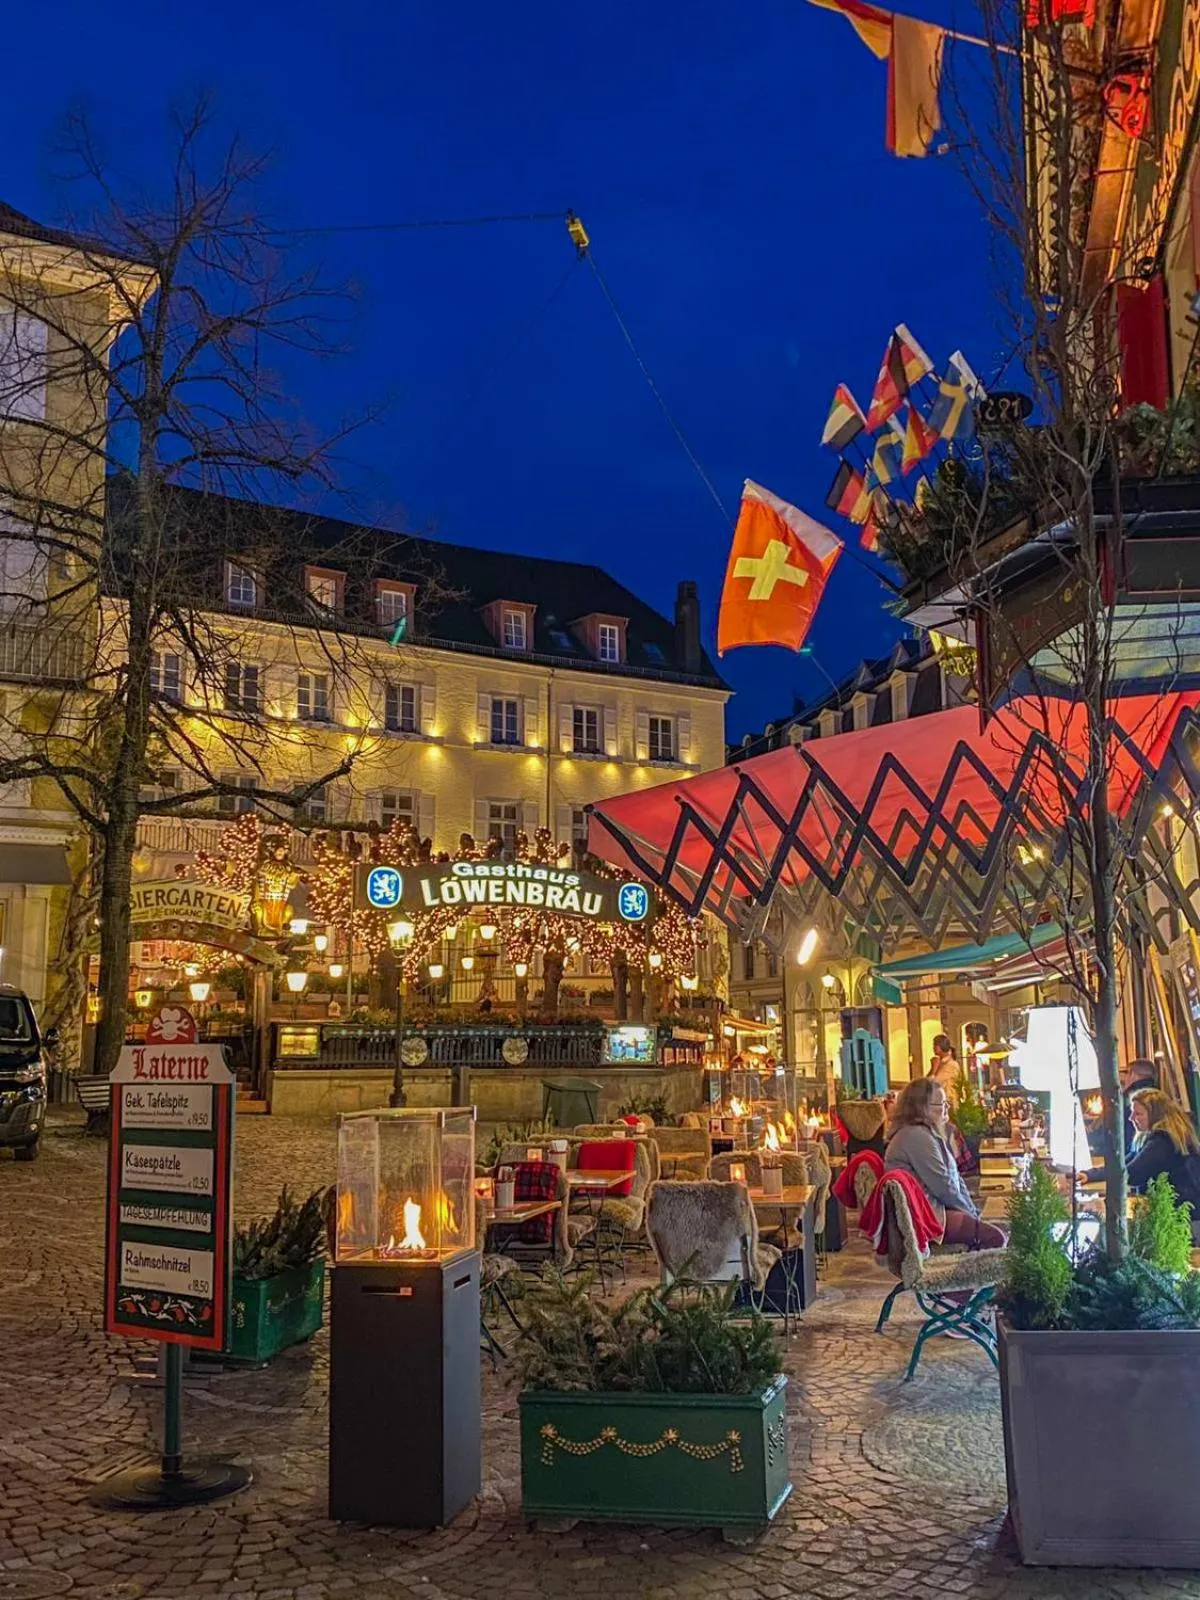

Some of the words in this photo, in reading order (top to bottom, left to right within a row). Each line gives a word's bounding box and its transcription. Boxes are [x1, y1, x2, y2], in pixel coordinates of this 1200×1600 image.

[452, 861, 580, 886] Gasthaus
[420, 876, 603, 916] LÖWENBRÄU
[131, 1048, 209, 1081] Laterne
[147, 1092, 189, 1114] Tafelspitz
[125, 1249, 191, 1274] Rahmschnitzel
